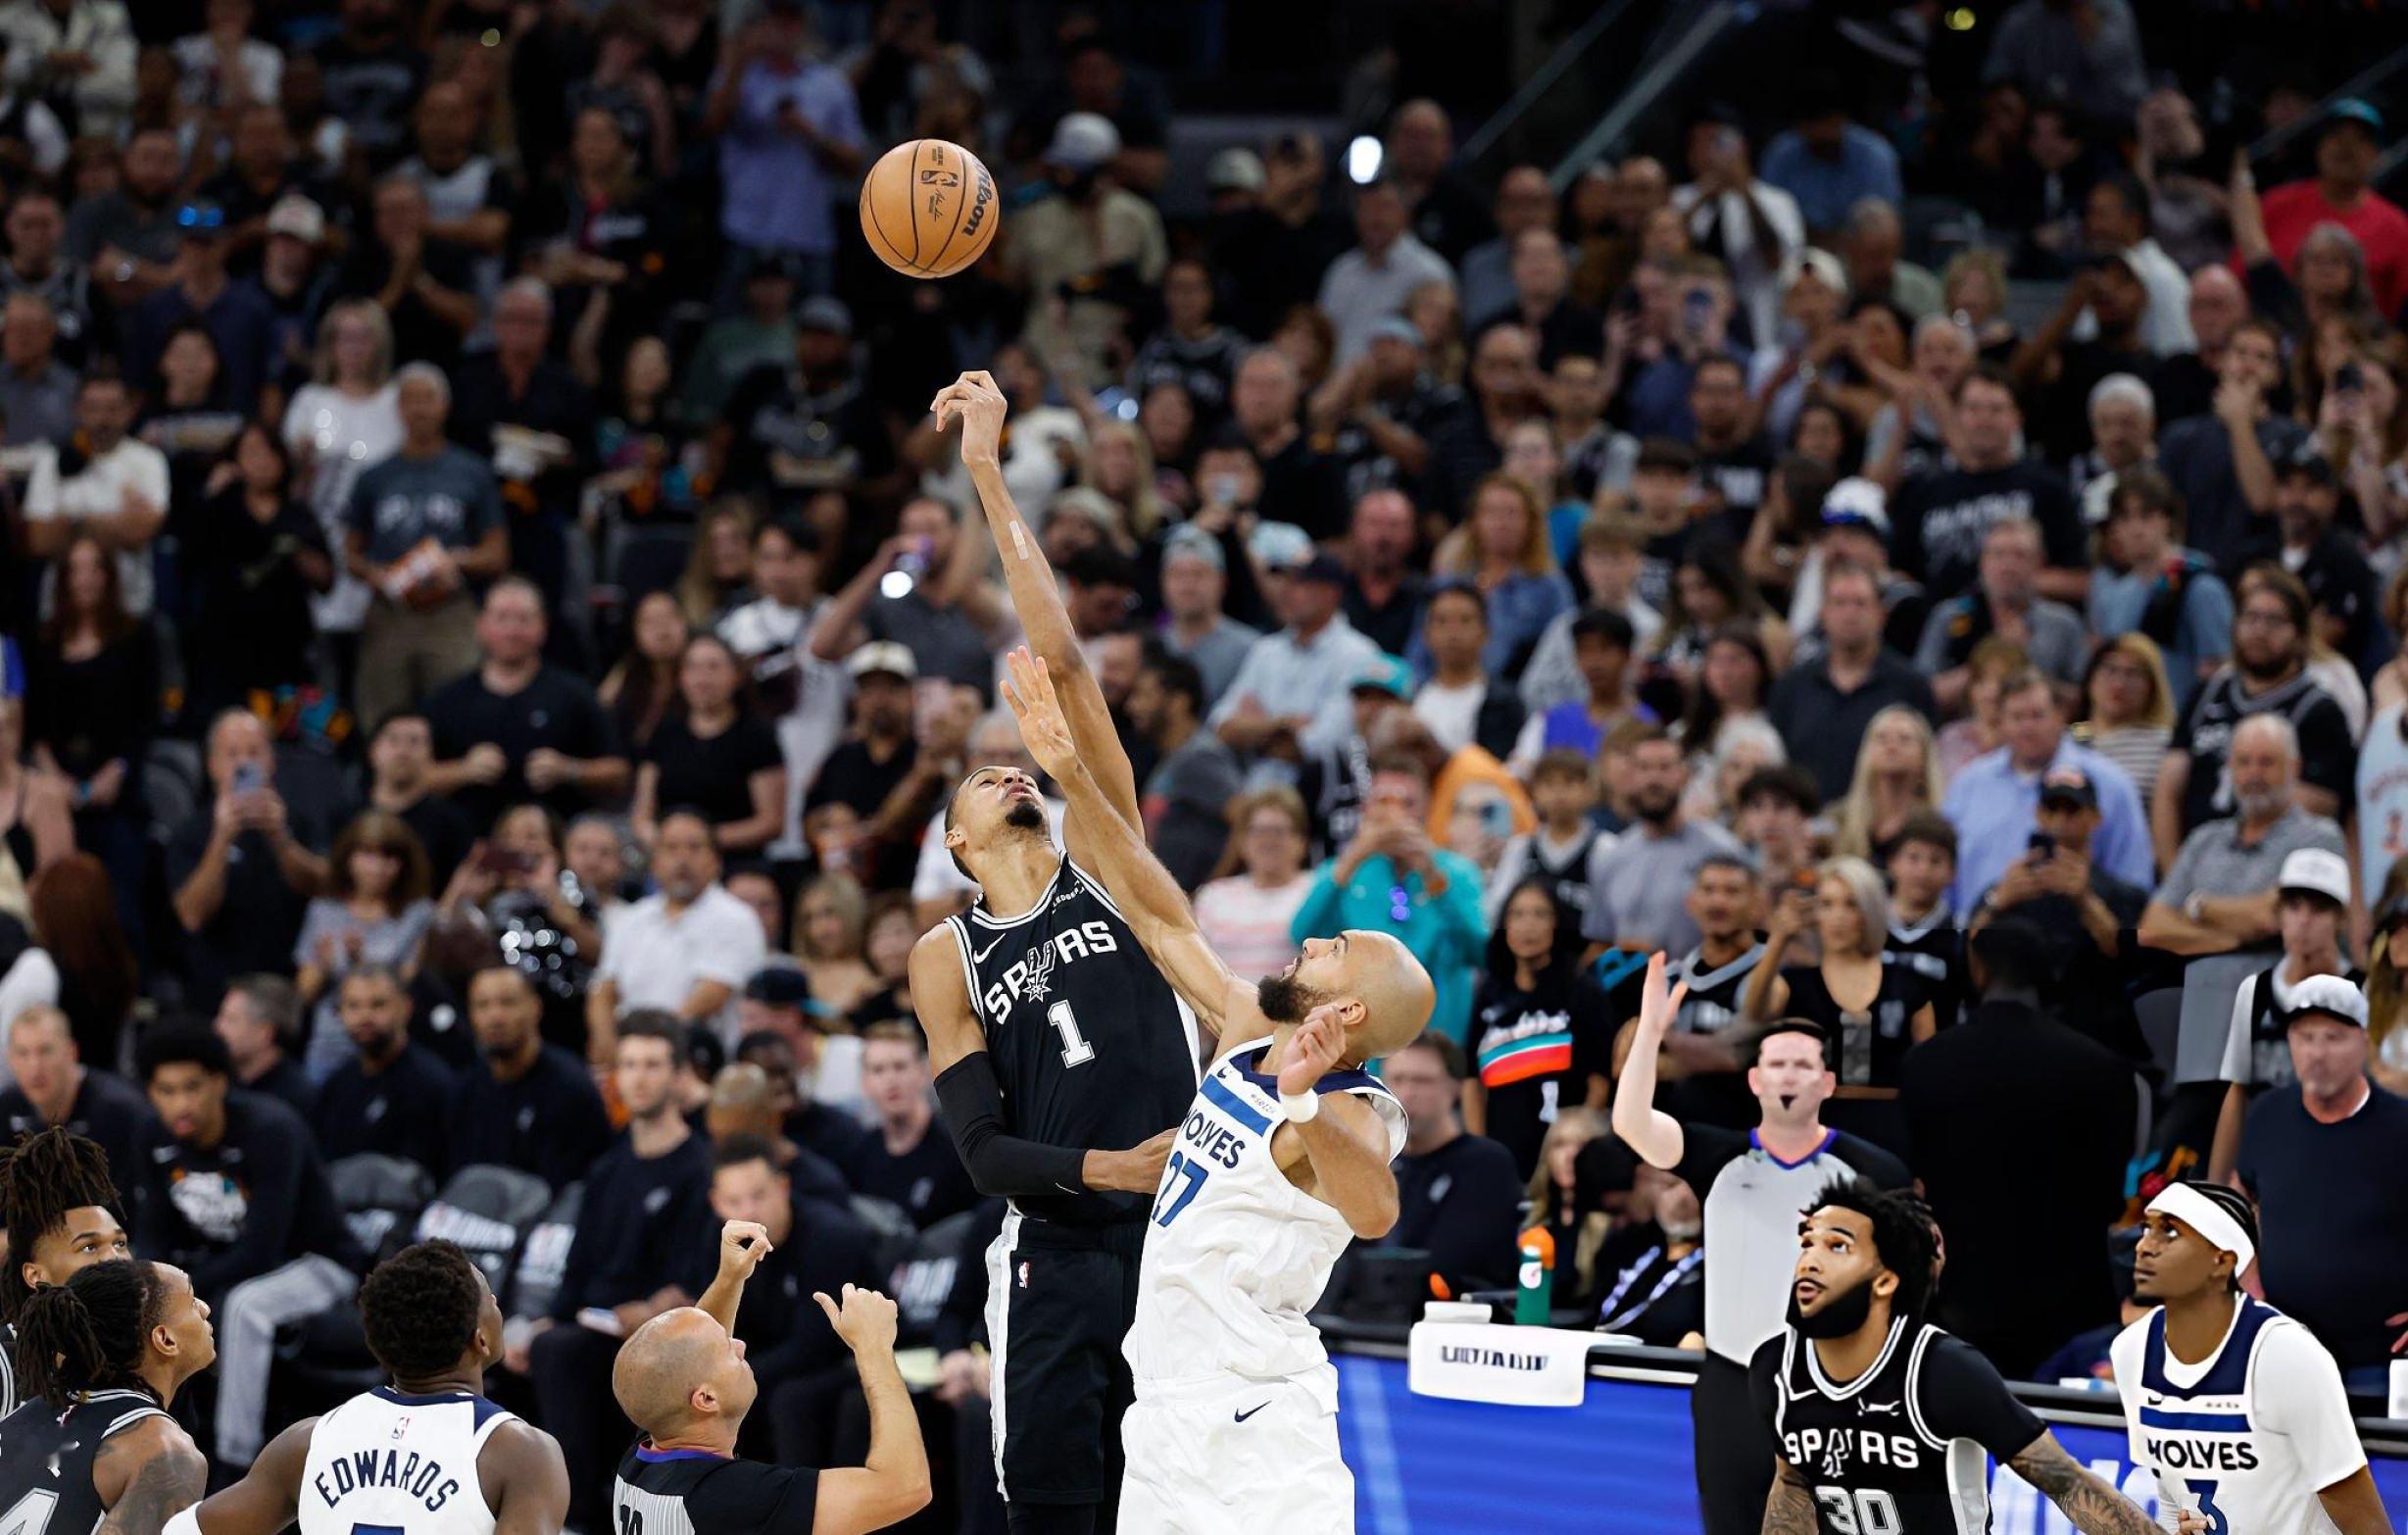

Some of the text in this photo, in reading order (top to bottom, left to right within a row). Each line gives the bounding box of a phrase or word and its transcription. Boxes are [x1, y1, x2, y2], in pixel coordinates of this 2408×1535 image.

[984, 920, 1117, 1025] SPURS
[1047, 999, 1095, 1068] 1
[315, 1449, 459, 1511] EDWARDS
[1815, 1485, 1903, 1535] 30
